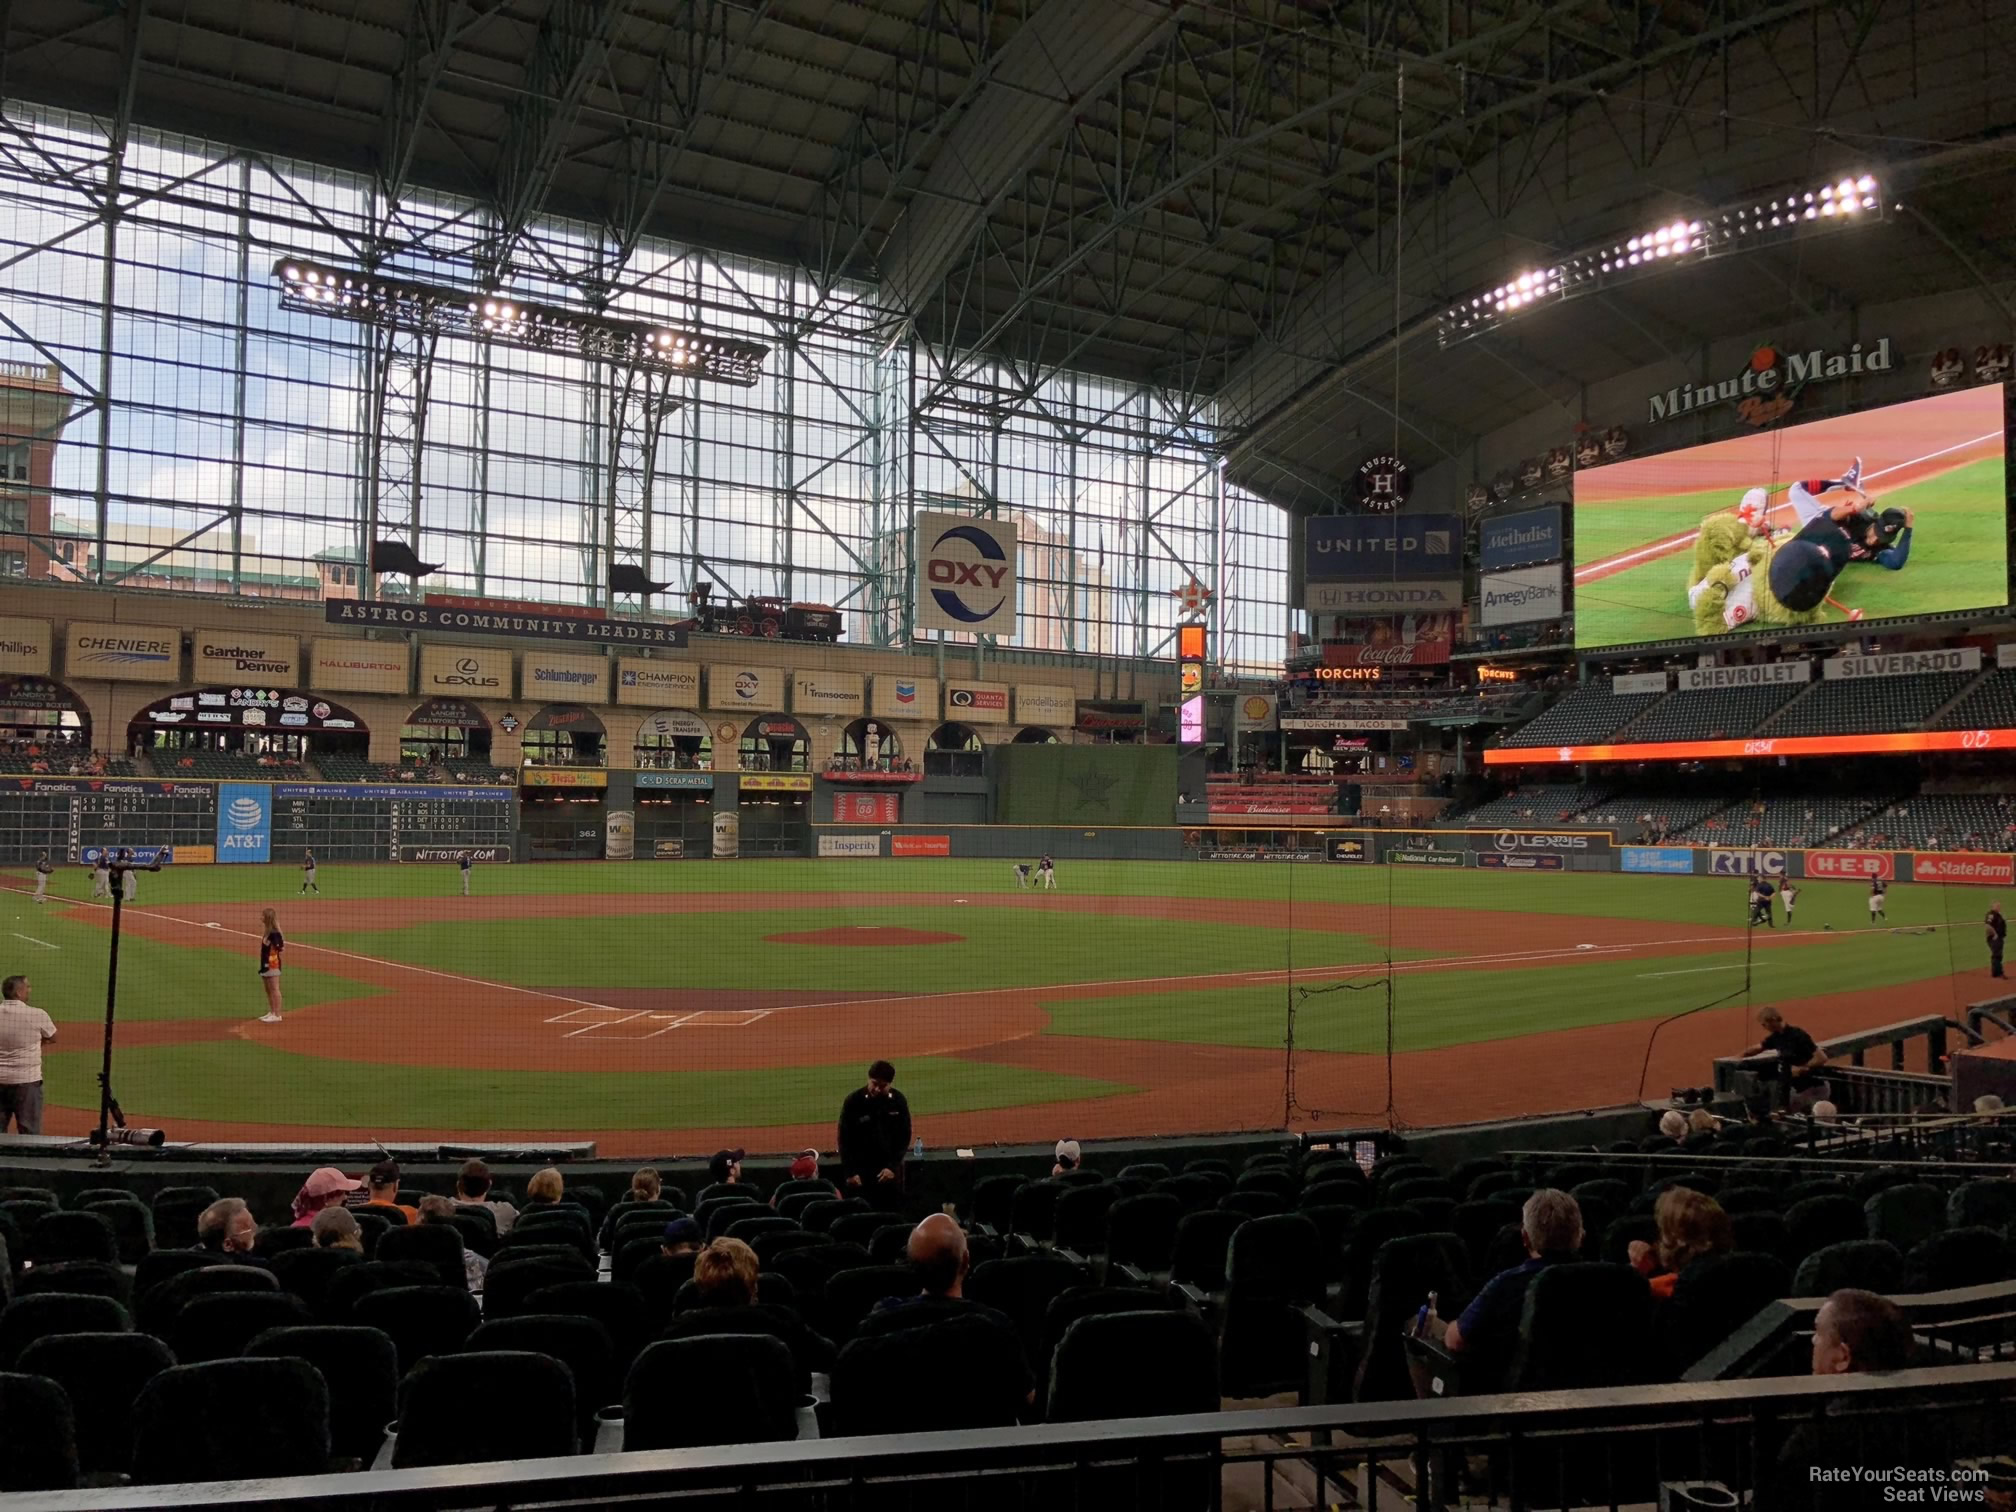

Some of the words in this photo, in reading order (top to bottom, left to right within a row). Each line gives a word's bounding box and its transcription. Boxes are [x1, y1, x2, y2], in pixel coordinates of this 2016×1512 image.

[1648, 369, 1777, 423] Minute
[1786, 338, 1892, 385] Maid
[1360, 456, 1406, 474] HOUSTON
[1372, 474, 1393, 493] H
[1362, 496, 1404, 510] ASTROS
[1486, 526, 1553, 549] Methodist
[1316, 537, 1418, 554] UNITED
[928, 559, 1008, 588] OXY
[1344, 588, 1446, 605] HONDA
[542, 606, 589, 614] MAID
[342, 605, 428, 623] ASTROS
[440, 612, 577, 634] COMMUNITY
[588, 624, 676, 642] LEADERS
[78, 637, 171, 654] CHENIERE
[203, 644, 264, 660] Gardner
[236, 659, 290, 673] Denver
[320, 660, 400, 671] HALLIBURTON
[1842, 652, 1962, 676] SILVERADO
[434, 675, 499, 687] LEXUS
[534, 668, 598, 686] Schlumberger
[638, 672, 696, 684] CHAMPION
[1690, 665, 1796, 688] CHEVROLET
[735, 680, 759, 689] OXY
[810, 689, 860, 700] Transocean
[35, 783, 76, 792] Fanatics
[655, 776, 662, 784] D
[665, 777, 687, 785] SCRAP
[688, 777, 708, 785] METAL
[104, 784, 143, 793] Fanatics
[174, 785, 211, 794] Fanatics
[860, 805, 872, 814] 66
[1245, 805, 1291, 813] Budweiser
[224, 834, 264, 848] AT&T
[580, 830, 596, 838] 362
[834, 840, 876, 851] Insperity
[1402, 854, 1426, 862] National
[1712, 851, 1784, 874] RTIC
